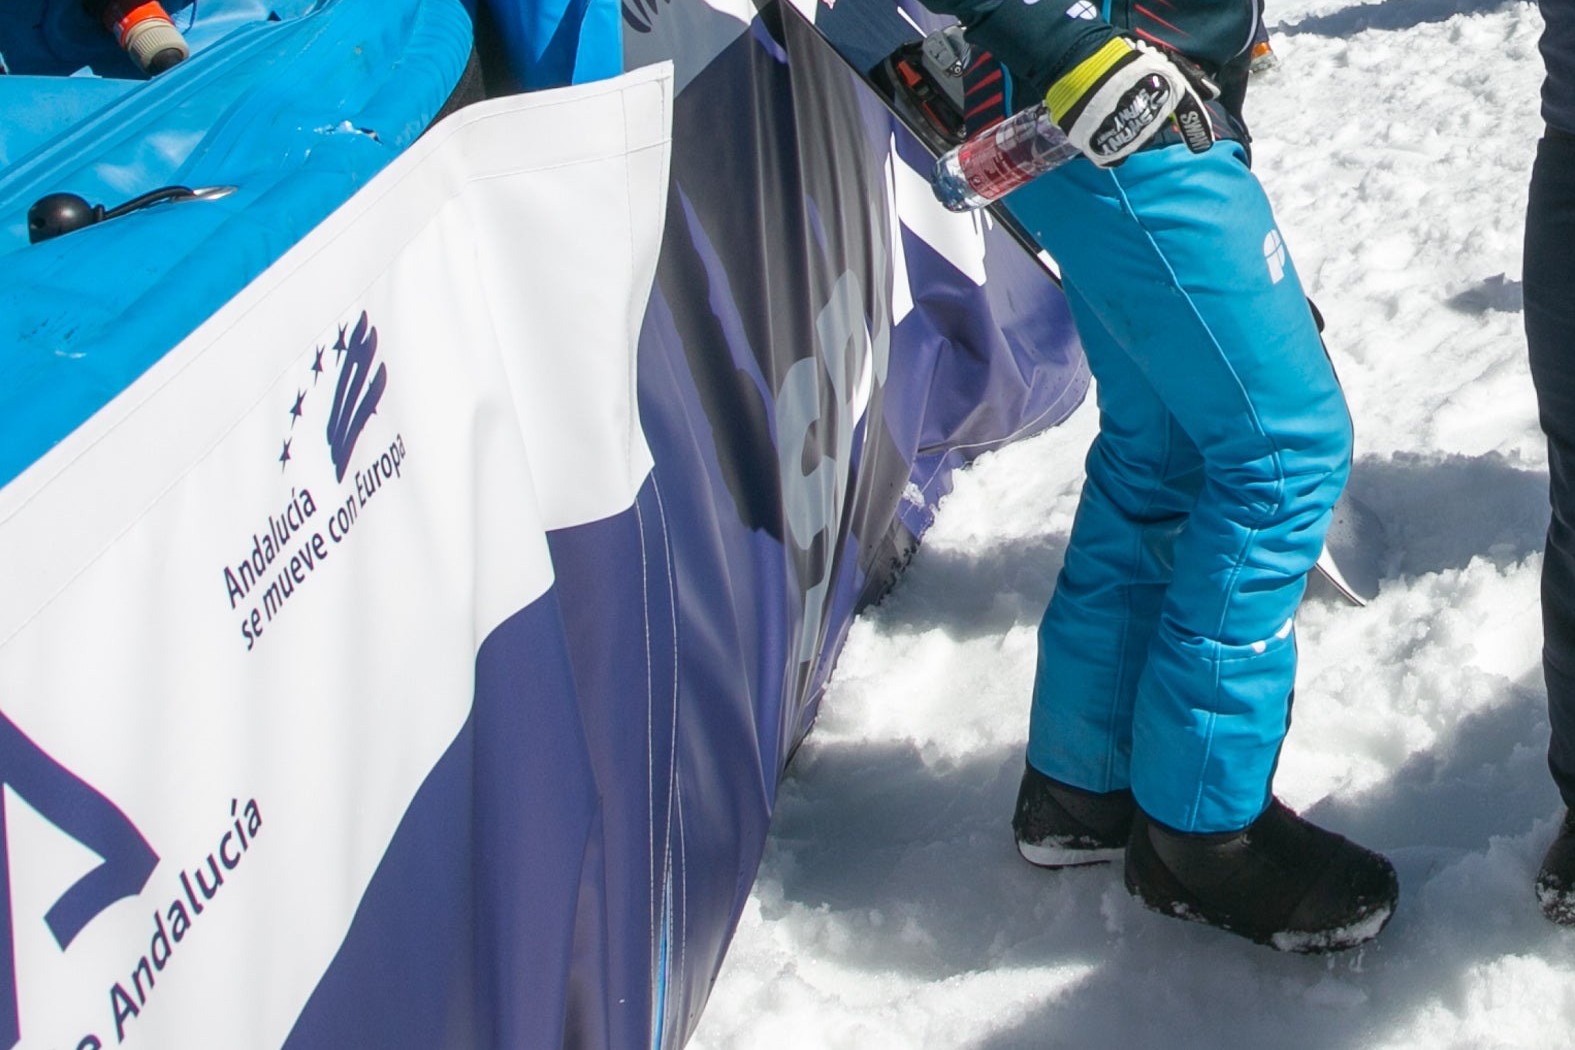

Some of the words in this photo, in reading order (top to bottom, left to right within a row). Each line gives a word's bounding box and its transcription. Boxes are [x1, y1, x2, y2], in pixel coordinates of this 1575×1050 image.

[223, 486, 317, 610] Andalucía
[241, 608, 264, 651] se
[262, 533, 328, 622] mueve
[328, 495, 358, 543] con
[355, 433, 406, 509] Europa
[109, 798, 263, 1045] Andalucía
